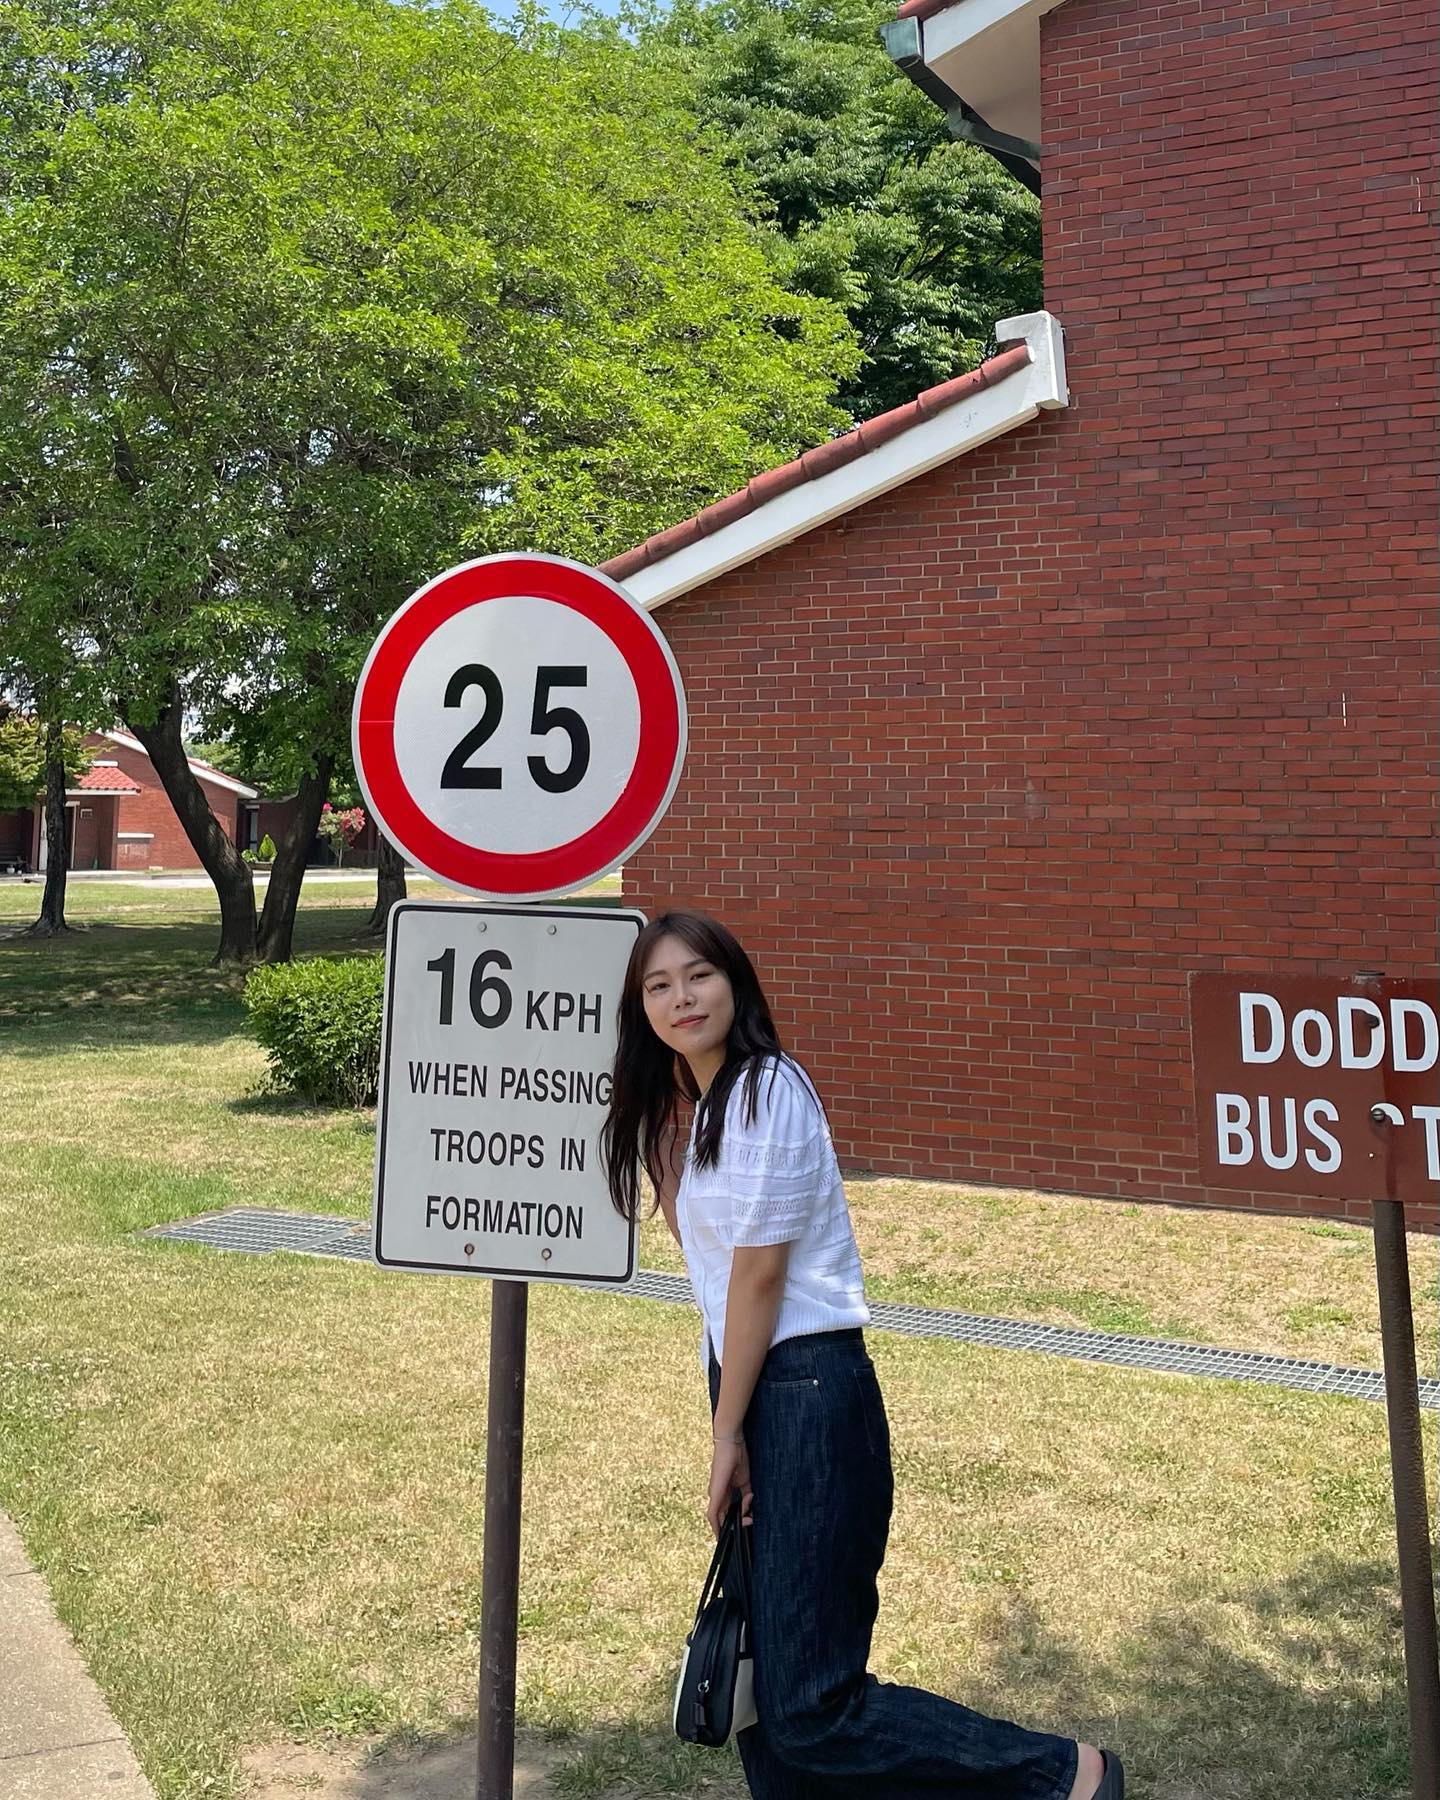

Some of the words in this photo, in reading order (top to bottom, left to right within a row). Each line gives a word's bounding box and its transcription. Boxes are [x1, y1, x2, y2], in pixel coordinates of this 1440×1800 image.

[440, 663, 591, 794] 25
[427, 947, 513, 1029] 16
[525, 990, 602, 1034] KPH
[408, 1061, 488, 1098] WHEN
[500, 1067, 613, 1106] PASSING
[430, 1128, 545, 1168] TROOPS
[560, 1137, 586, 1172] IN
[1216, 1093, 1342, 1174] BUS
[1370, 1102, 1440, 1181] T
[425, 1195, 584, 1239] FORMATION
